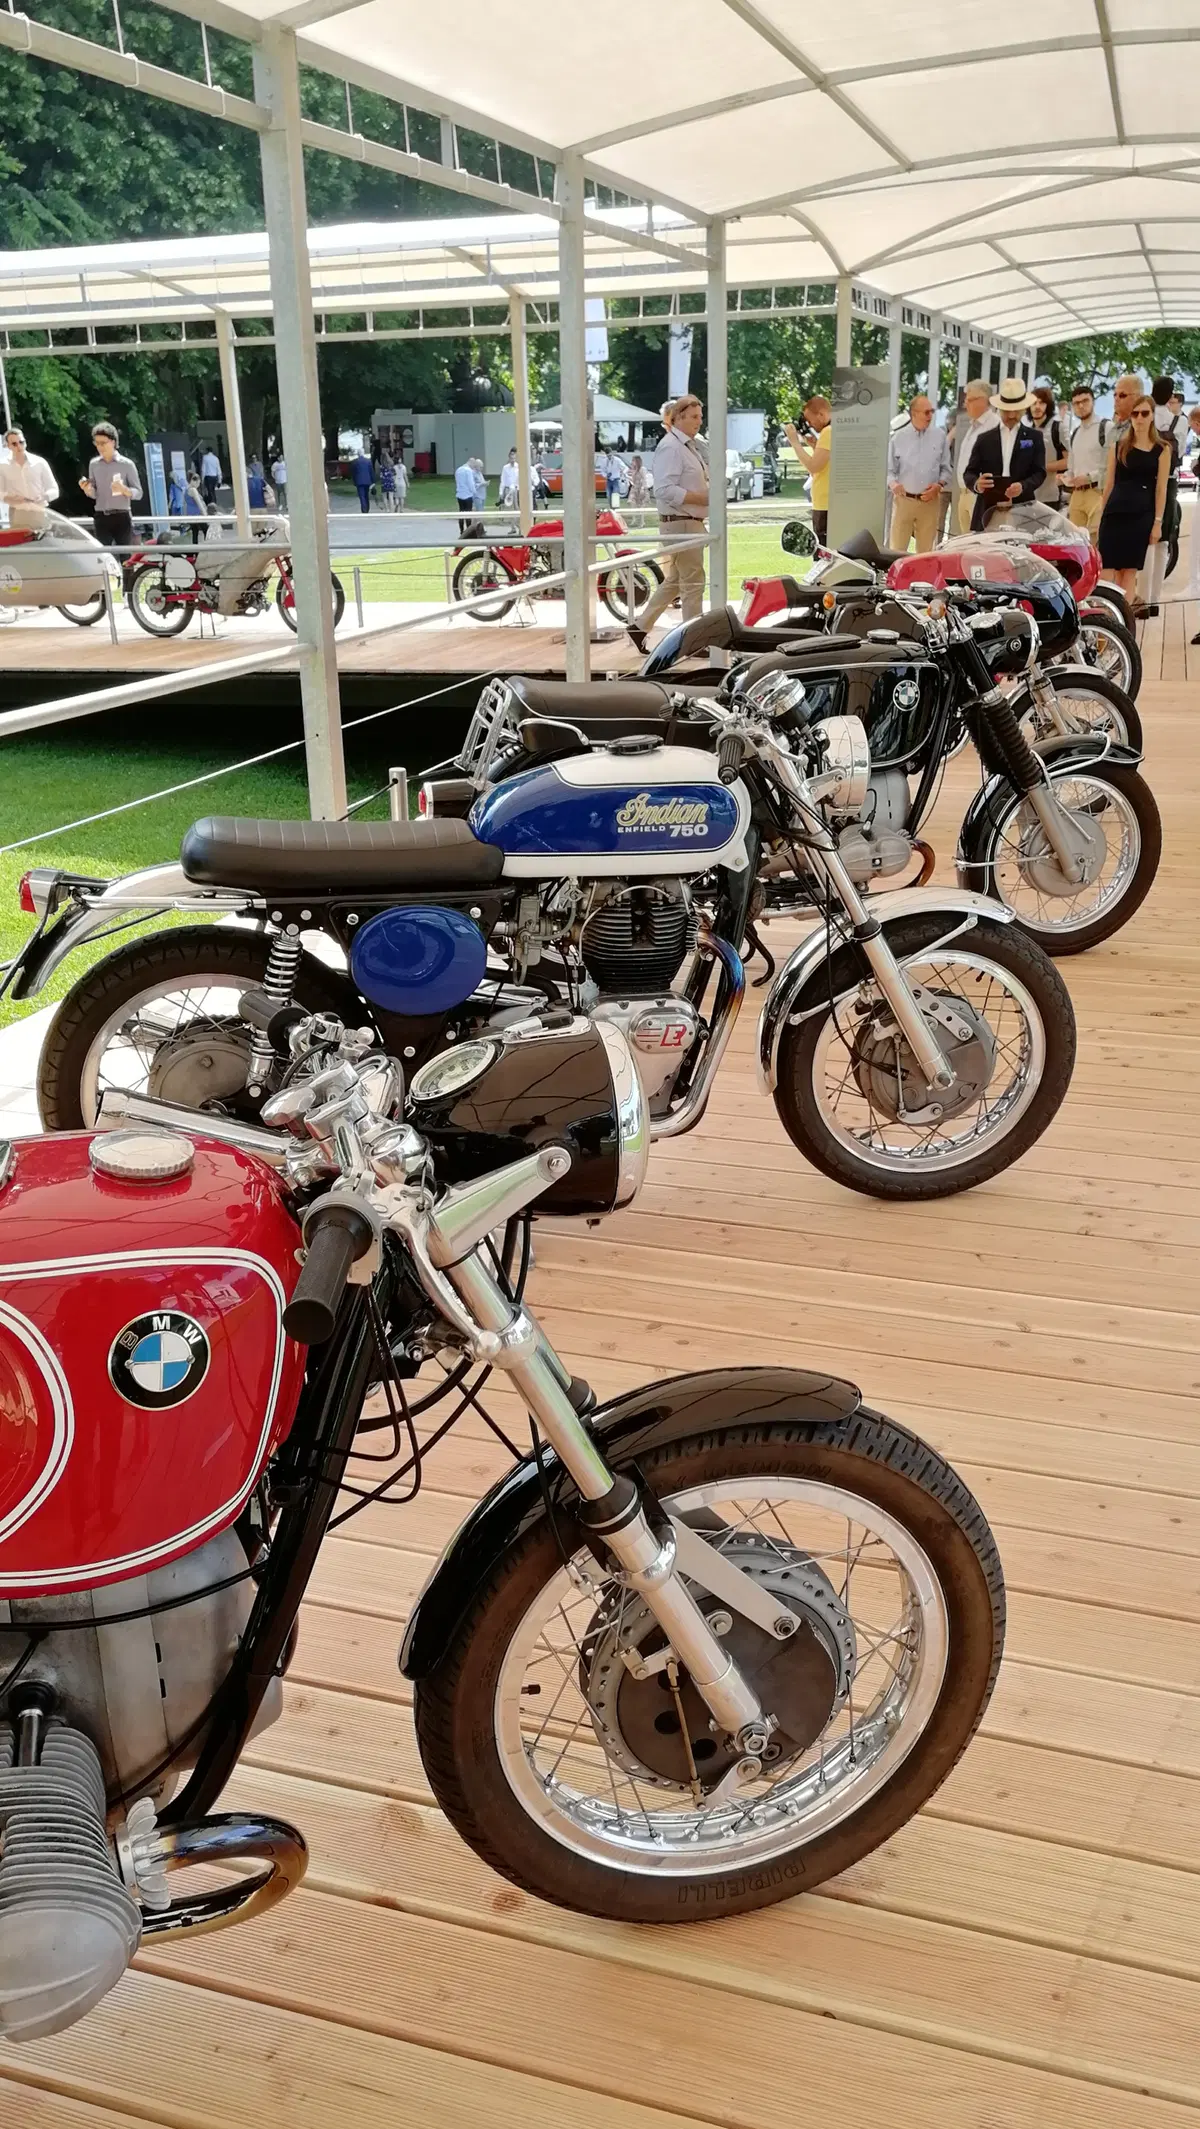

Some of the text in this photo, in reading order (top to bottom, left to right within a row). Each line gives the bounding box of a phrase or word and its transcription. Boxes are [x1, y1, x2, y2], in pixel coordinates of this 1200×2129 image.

[616, 793, 709, 826] Indian
[617, 823, 709, 838] ENFIELD 750
[119, 1315, 203, 1351] BMW
[678, 1858, 806, 1904] PIRELLI
